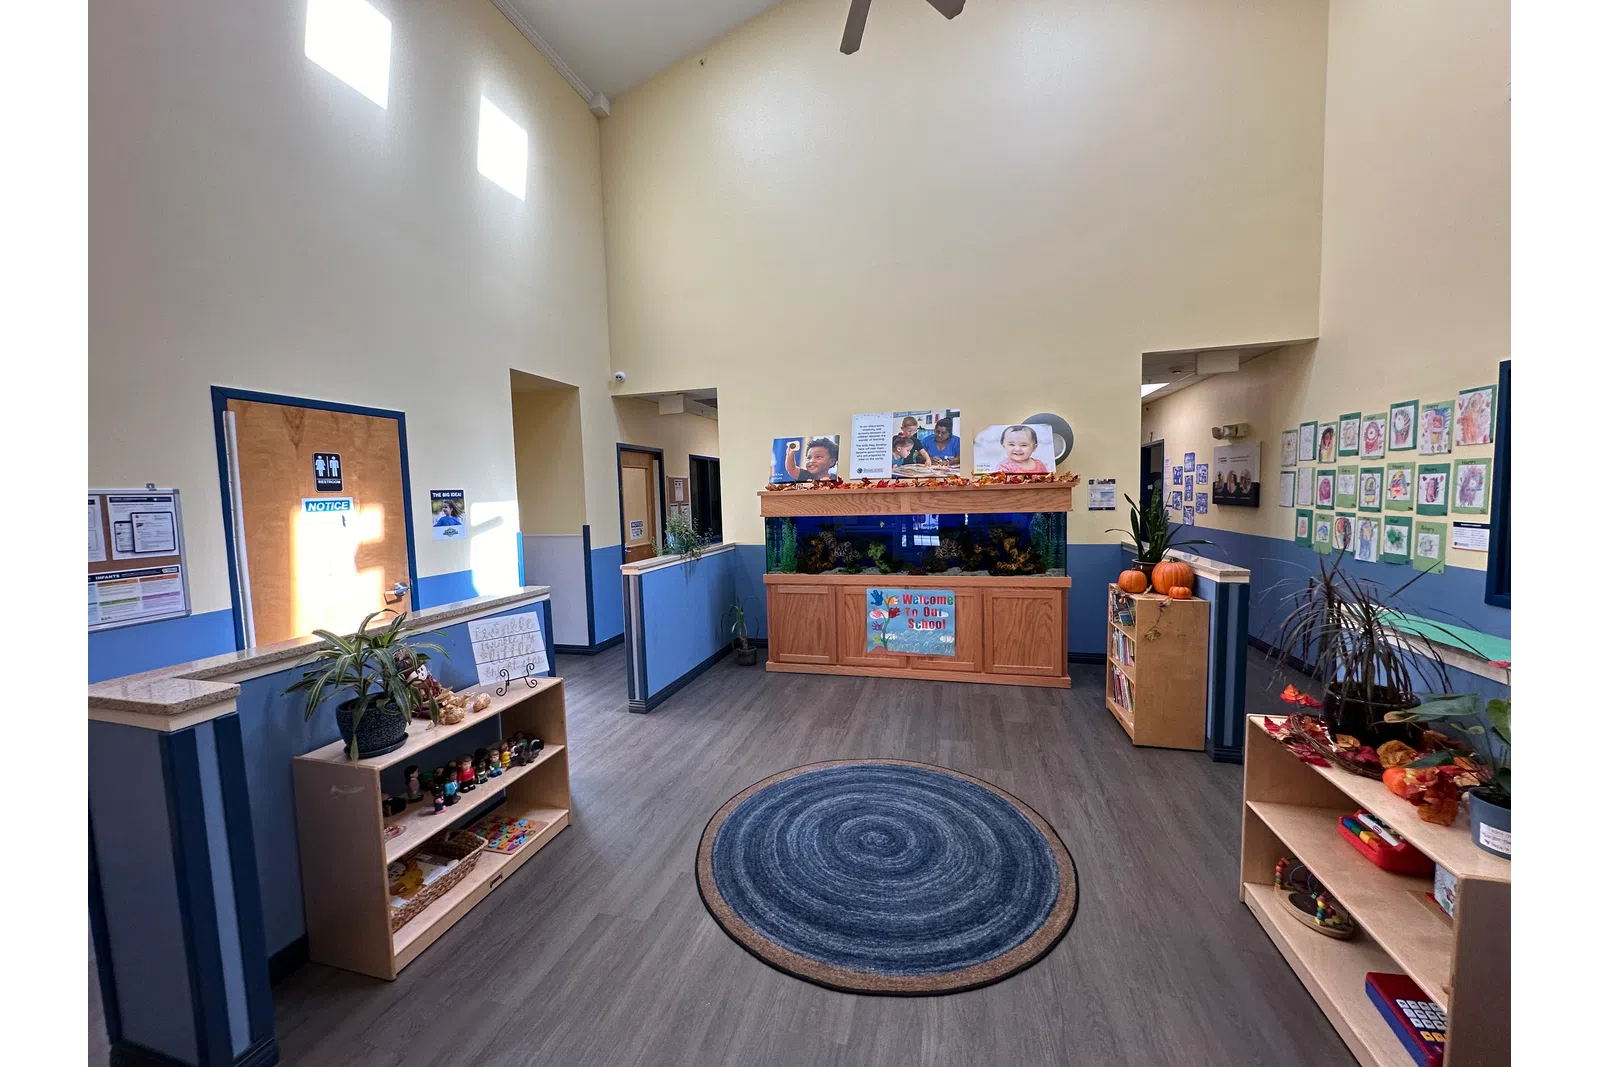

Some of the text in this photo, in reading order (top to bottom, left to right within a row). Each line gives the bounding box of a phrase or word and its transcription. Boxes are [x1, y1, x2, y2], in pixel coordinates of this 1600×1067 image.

[308, 501, 349, 511] NOTICE
[902, 594, 954, 605] Welcome
[905, 606, 943, 617] To Our
[908, 618, 946, 629] School
